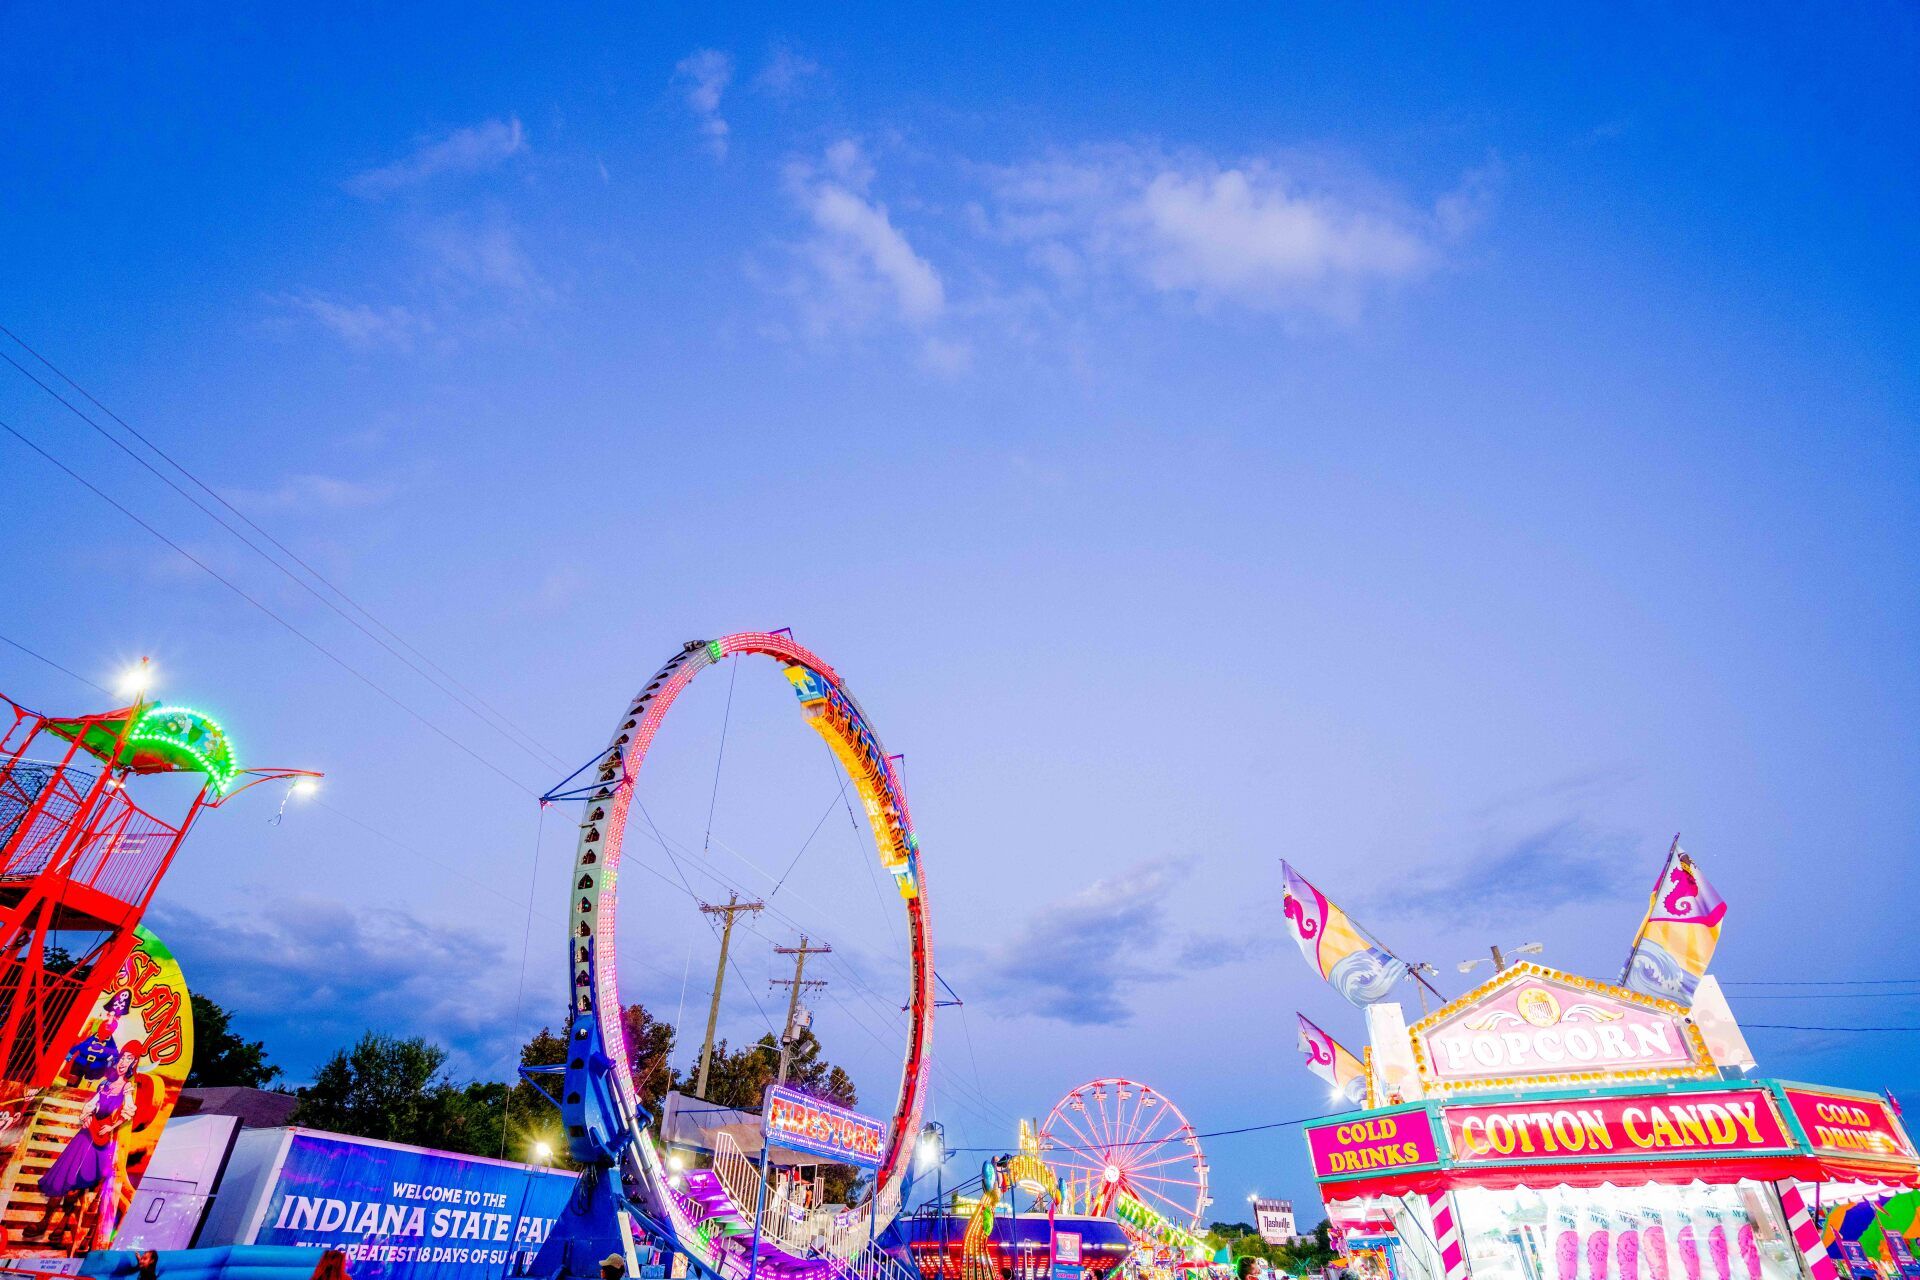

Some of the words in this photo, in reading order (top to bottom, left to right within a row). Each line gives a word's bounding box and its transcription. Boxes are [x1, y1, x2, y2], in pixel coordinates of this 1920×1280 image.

[104, 934, 183, 1065] SLAND
[1440, 1022, 1672, 1069] POPCORN
[769, 1097, 880, 1156] FIRESTORM
[1336, 1118, 1398, 1145] COLD
[1462, 1109, 1614, 1155] COTTON
[1622, 1101, 1764, 1149] CANDY
[1816, 1102, 1871, 1127] COLD
[1328, 1142, 1420, 1173] DRINKS
[393, 1182, 462, 1204] WELCOME
[464, 1190, 481, 1206] TO
[483, 1192, 507, 1208] THE
[273, 1194, 426, 1237] INDIANA
[431, 1208, 512, 1242] STATE
[515, 1216, 558, 1243] FAI
[416, 1246, 430, 1263] 18
[432, 1247, 469, 1263] DAYS
[471, 1249, 488, 1264] OF
